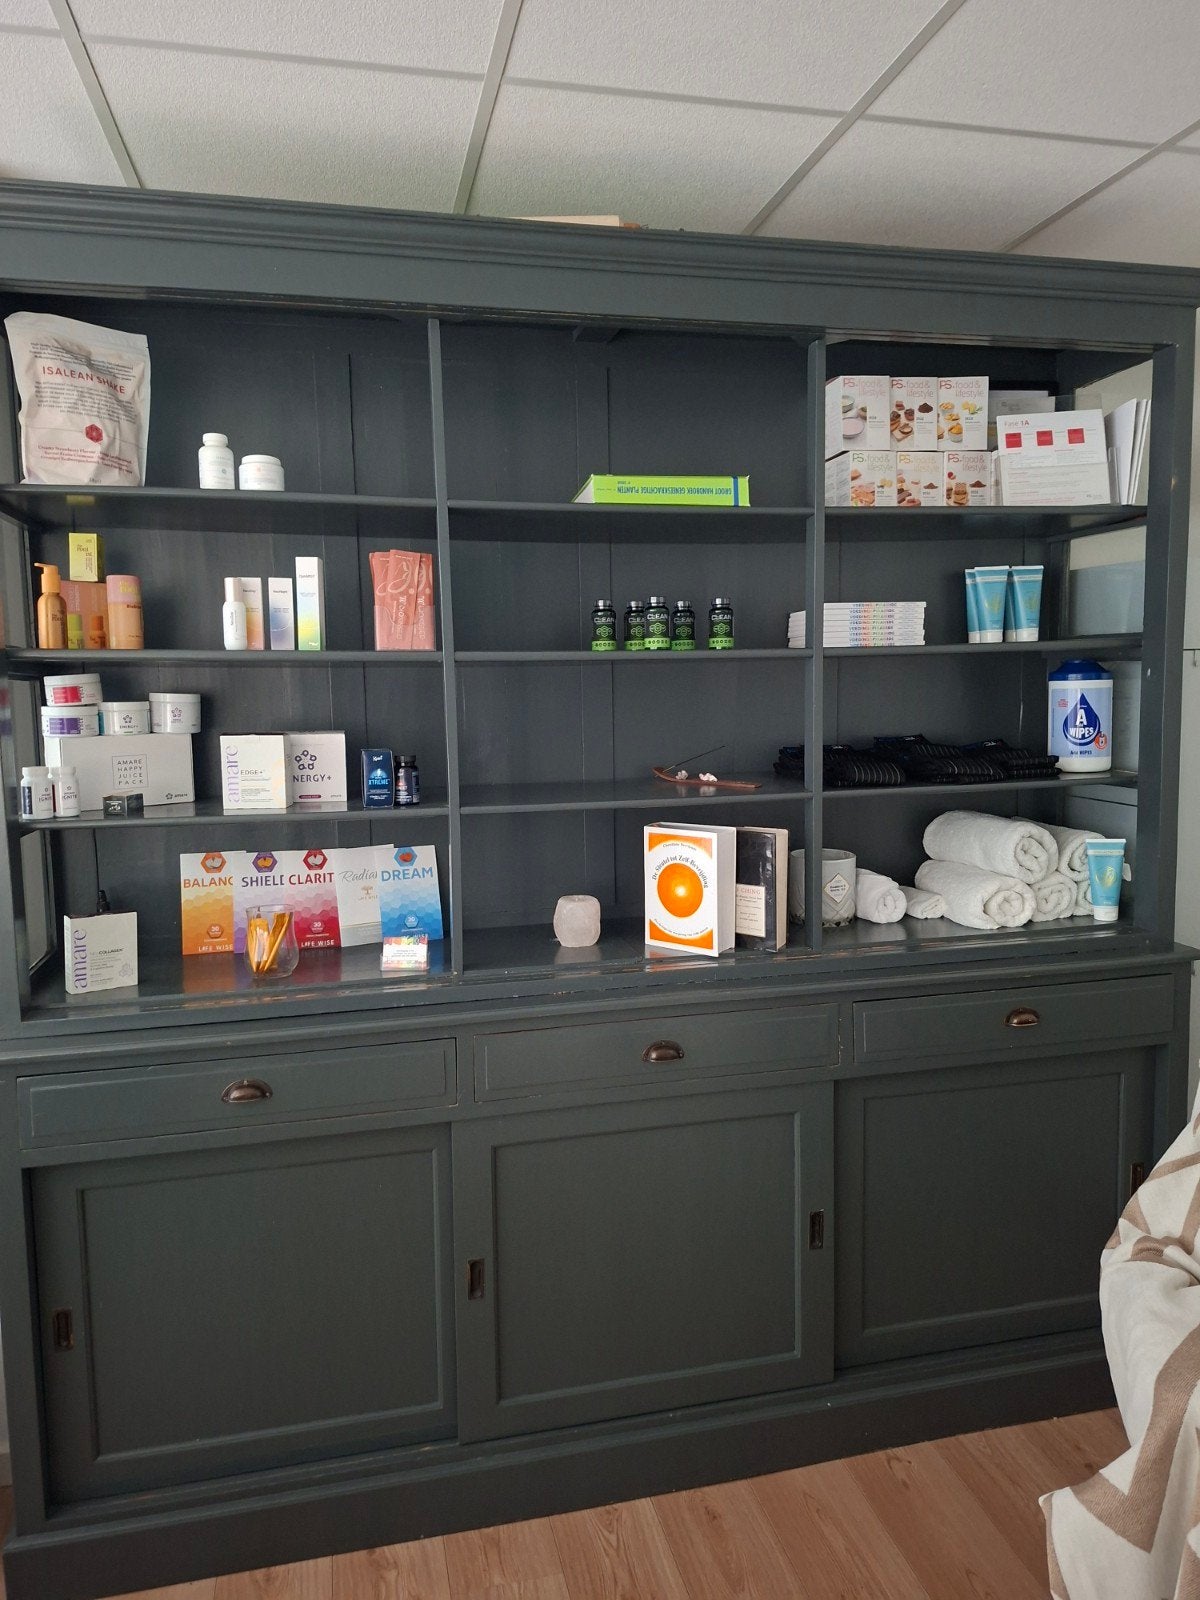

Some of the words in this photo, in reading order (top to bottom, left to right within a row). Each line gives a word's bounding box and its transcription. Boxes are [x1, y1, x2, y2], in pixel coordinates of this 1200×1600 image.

[43, 366, 94, 382] ISALEAN
[97, 376, 125, 394] SHAKE
[617, 485, 639, 494] PLANTEN
[1069, 727, 1094, 738] WIPES
[288, 872, 334, 885] CLARIT
[381, 867, 434, 882] DREAM
[74, 929, 87, 988] amare
